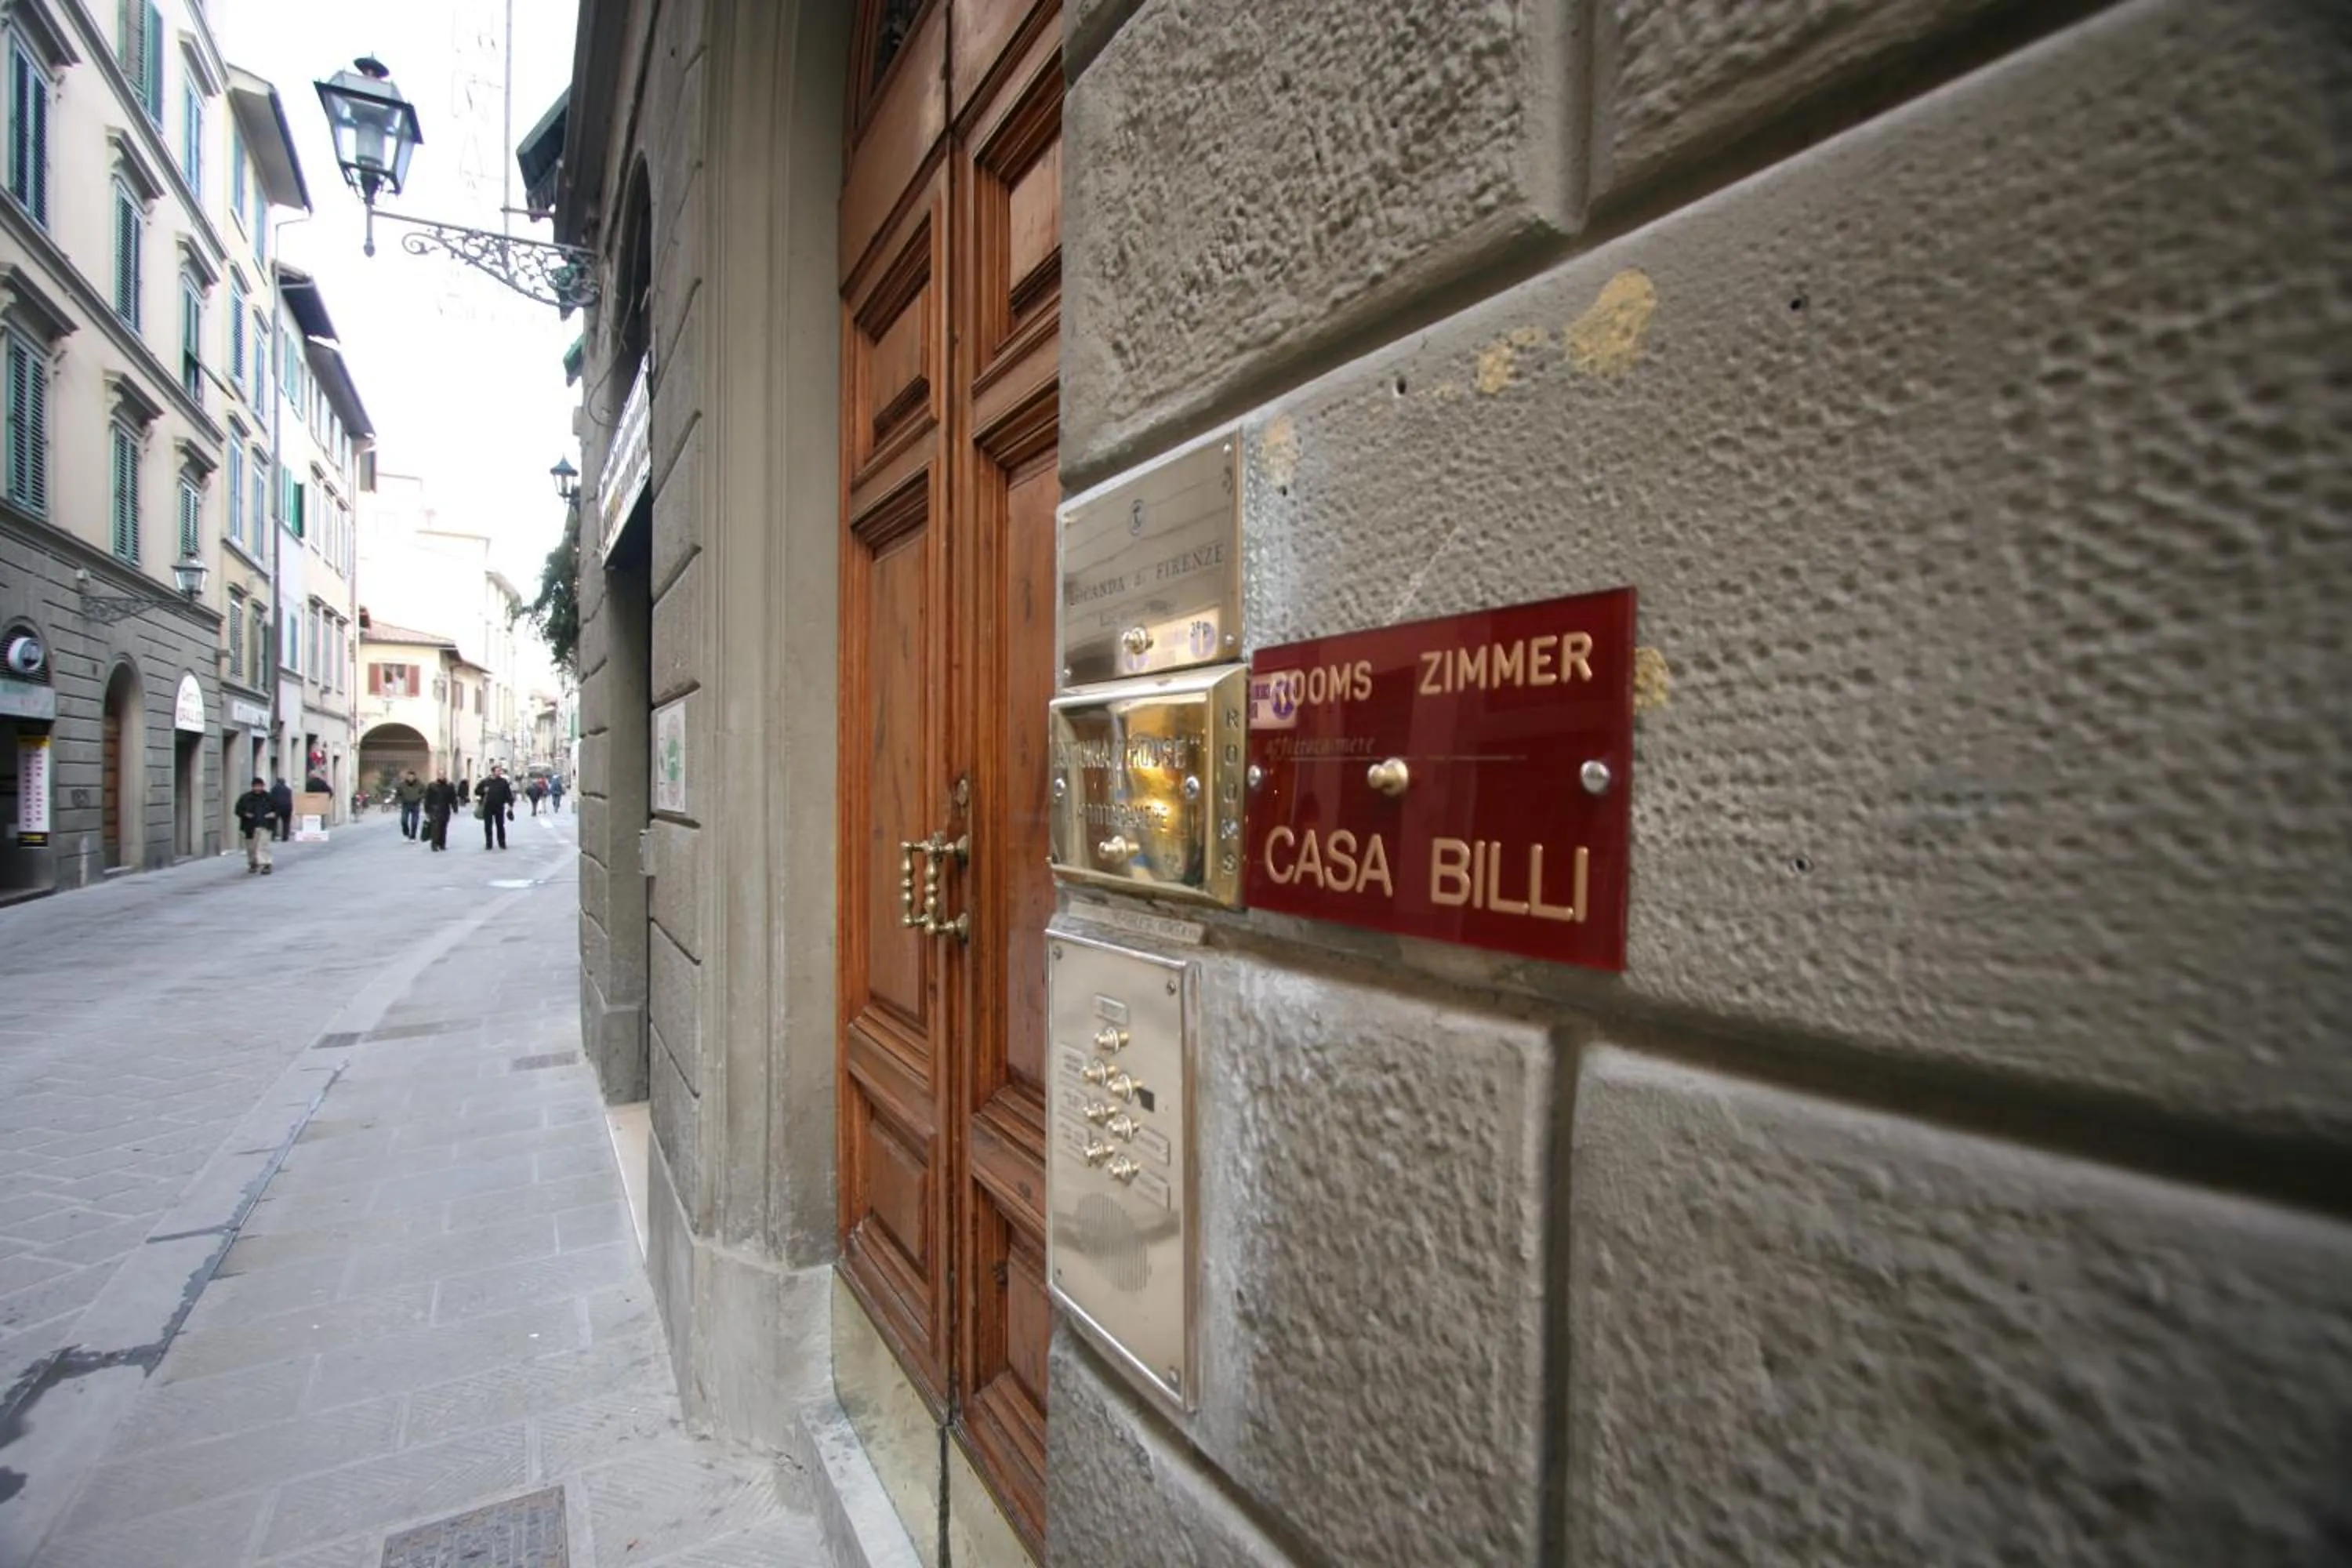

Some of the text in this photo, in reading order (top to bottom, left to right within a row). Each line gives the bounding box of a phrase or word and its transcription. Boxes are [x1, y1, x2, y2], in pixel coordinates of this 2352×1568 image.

[1156, 543, 1225, 580] FIRENZE
[1269, 660, 1374, 706] ROOMS
[1419, 631, 1593, 695] ZIMMER
[1265, 825, 1590, 923] CASA BILLI
